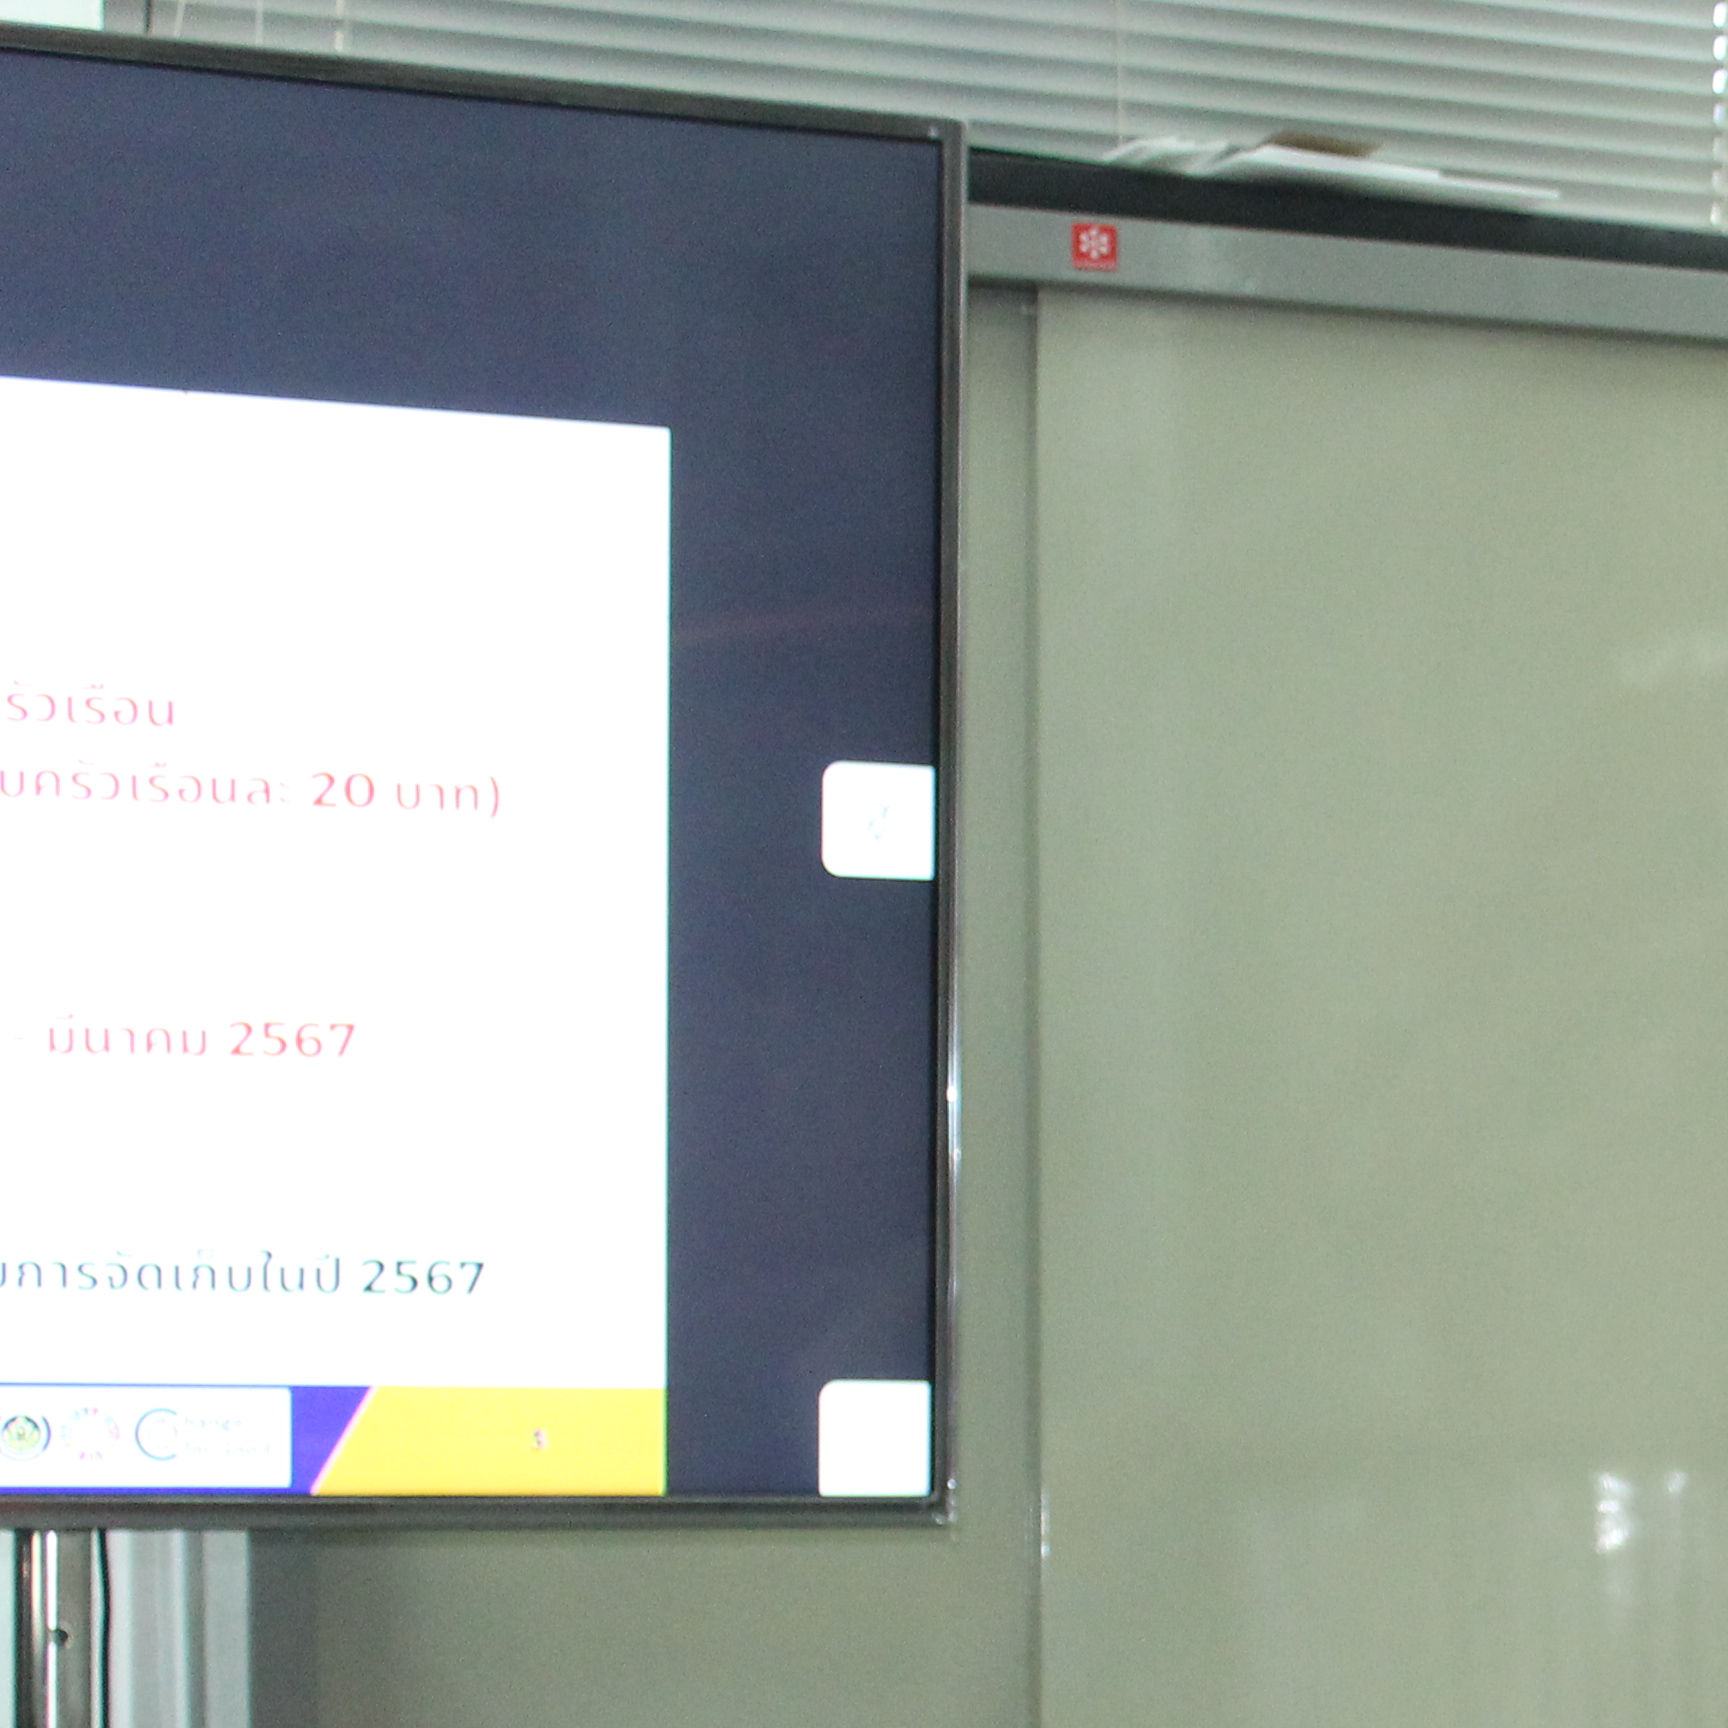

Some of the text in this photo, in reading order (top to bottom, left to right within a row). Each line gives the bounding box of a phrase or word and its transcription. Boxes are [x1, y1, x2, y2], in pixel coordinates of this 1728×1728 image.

[310, 771, 376, 808] 20
[395, 776, 501, 820] บาท)
[48, 1013, 207, 1057] มีนาคม
[228, 1020, 357, 1058] 2567
[361, 1258, 487, 1297] 2567
